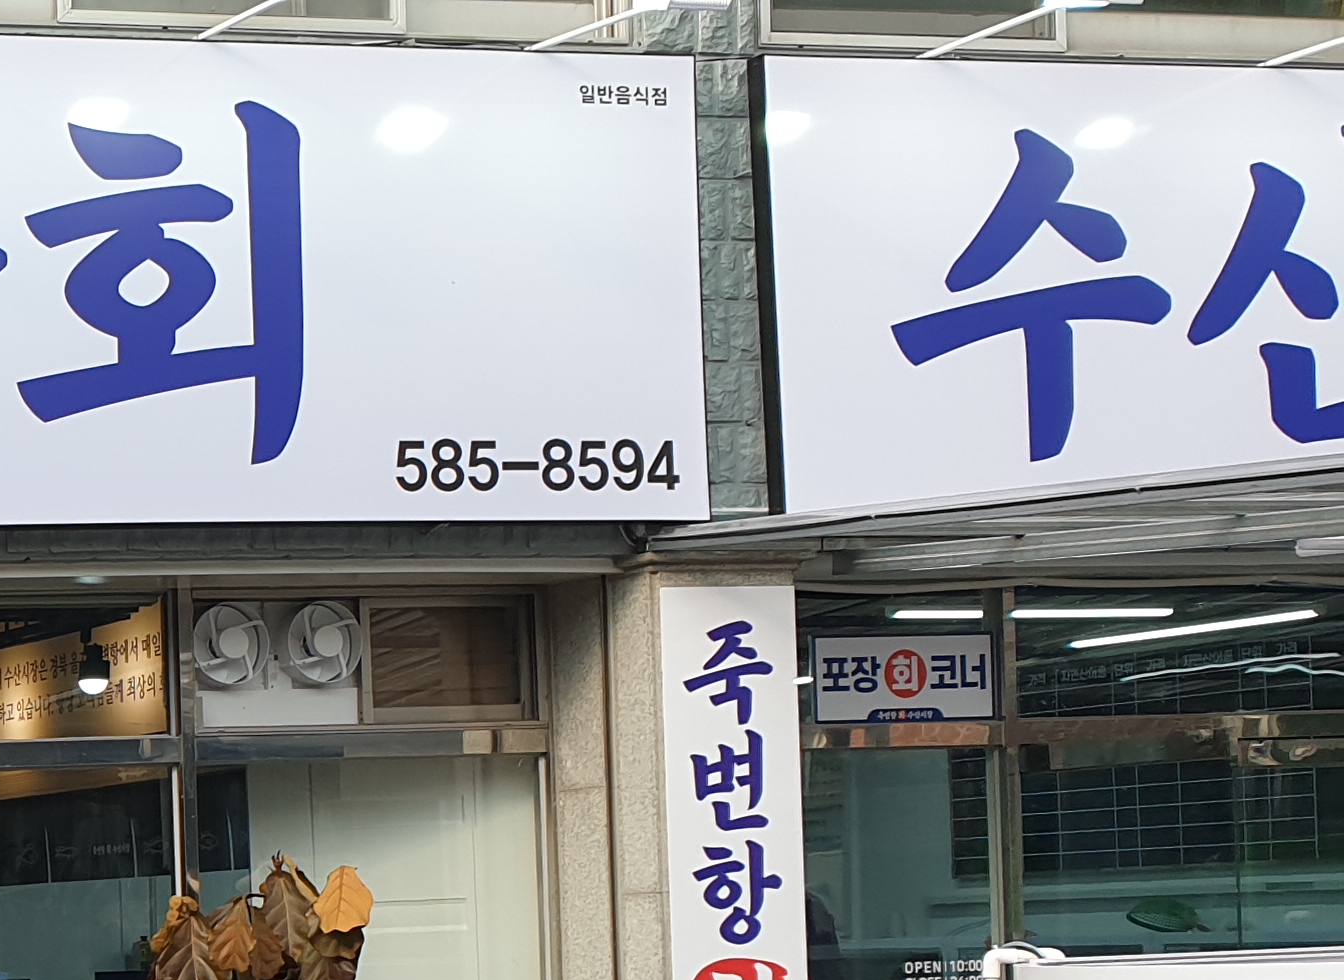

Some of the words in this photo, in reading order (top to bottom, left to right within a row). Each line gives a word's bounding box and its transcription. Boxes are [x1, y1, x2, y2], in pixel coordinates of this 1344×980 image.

[578, 84, 668, 107] 일반음식점
[395, 438, 681, 493] 585-8594
[821, 656, 882, 693] 포장
[891, 654, 920, 692] 회
[930, 653, 987, 690] 코너
[683, 620, 783, 945] 죽변항
[903, 961, 942, 974] OPEN
[949, 959, 984, 973] 10:00
